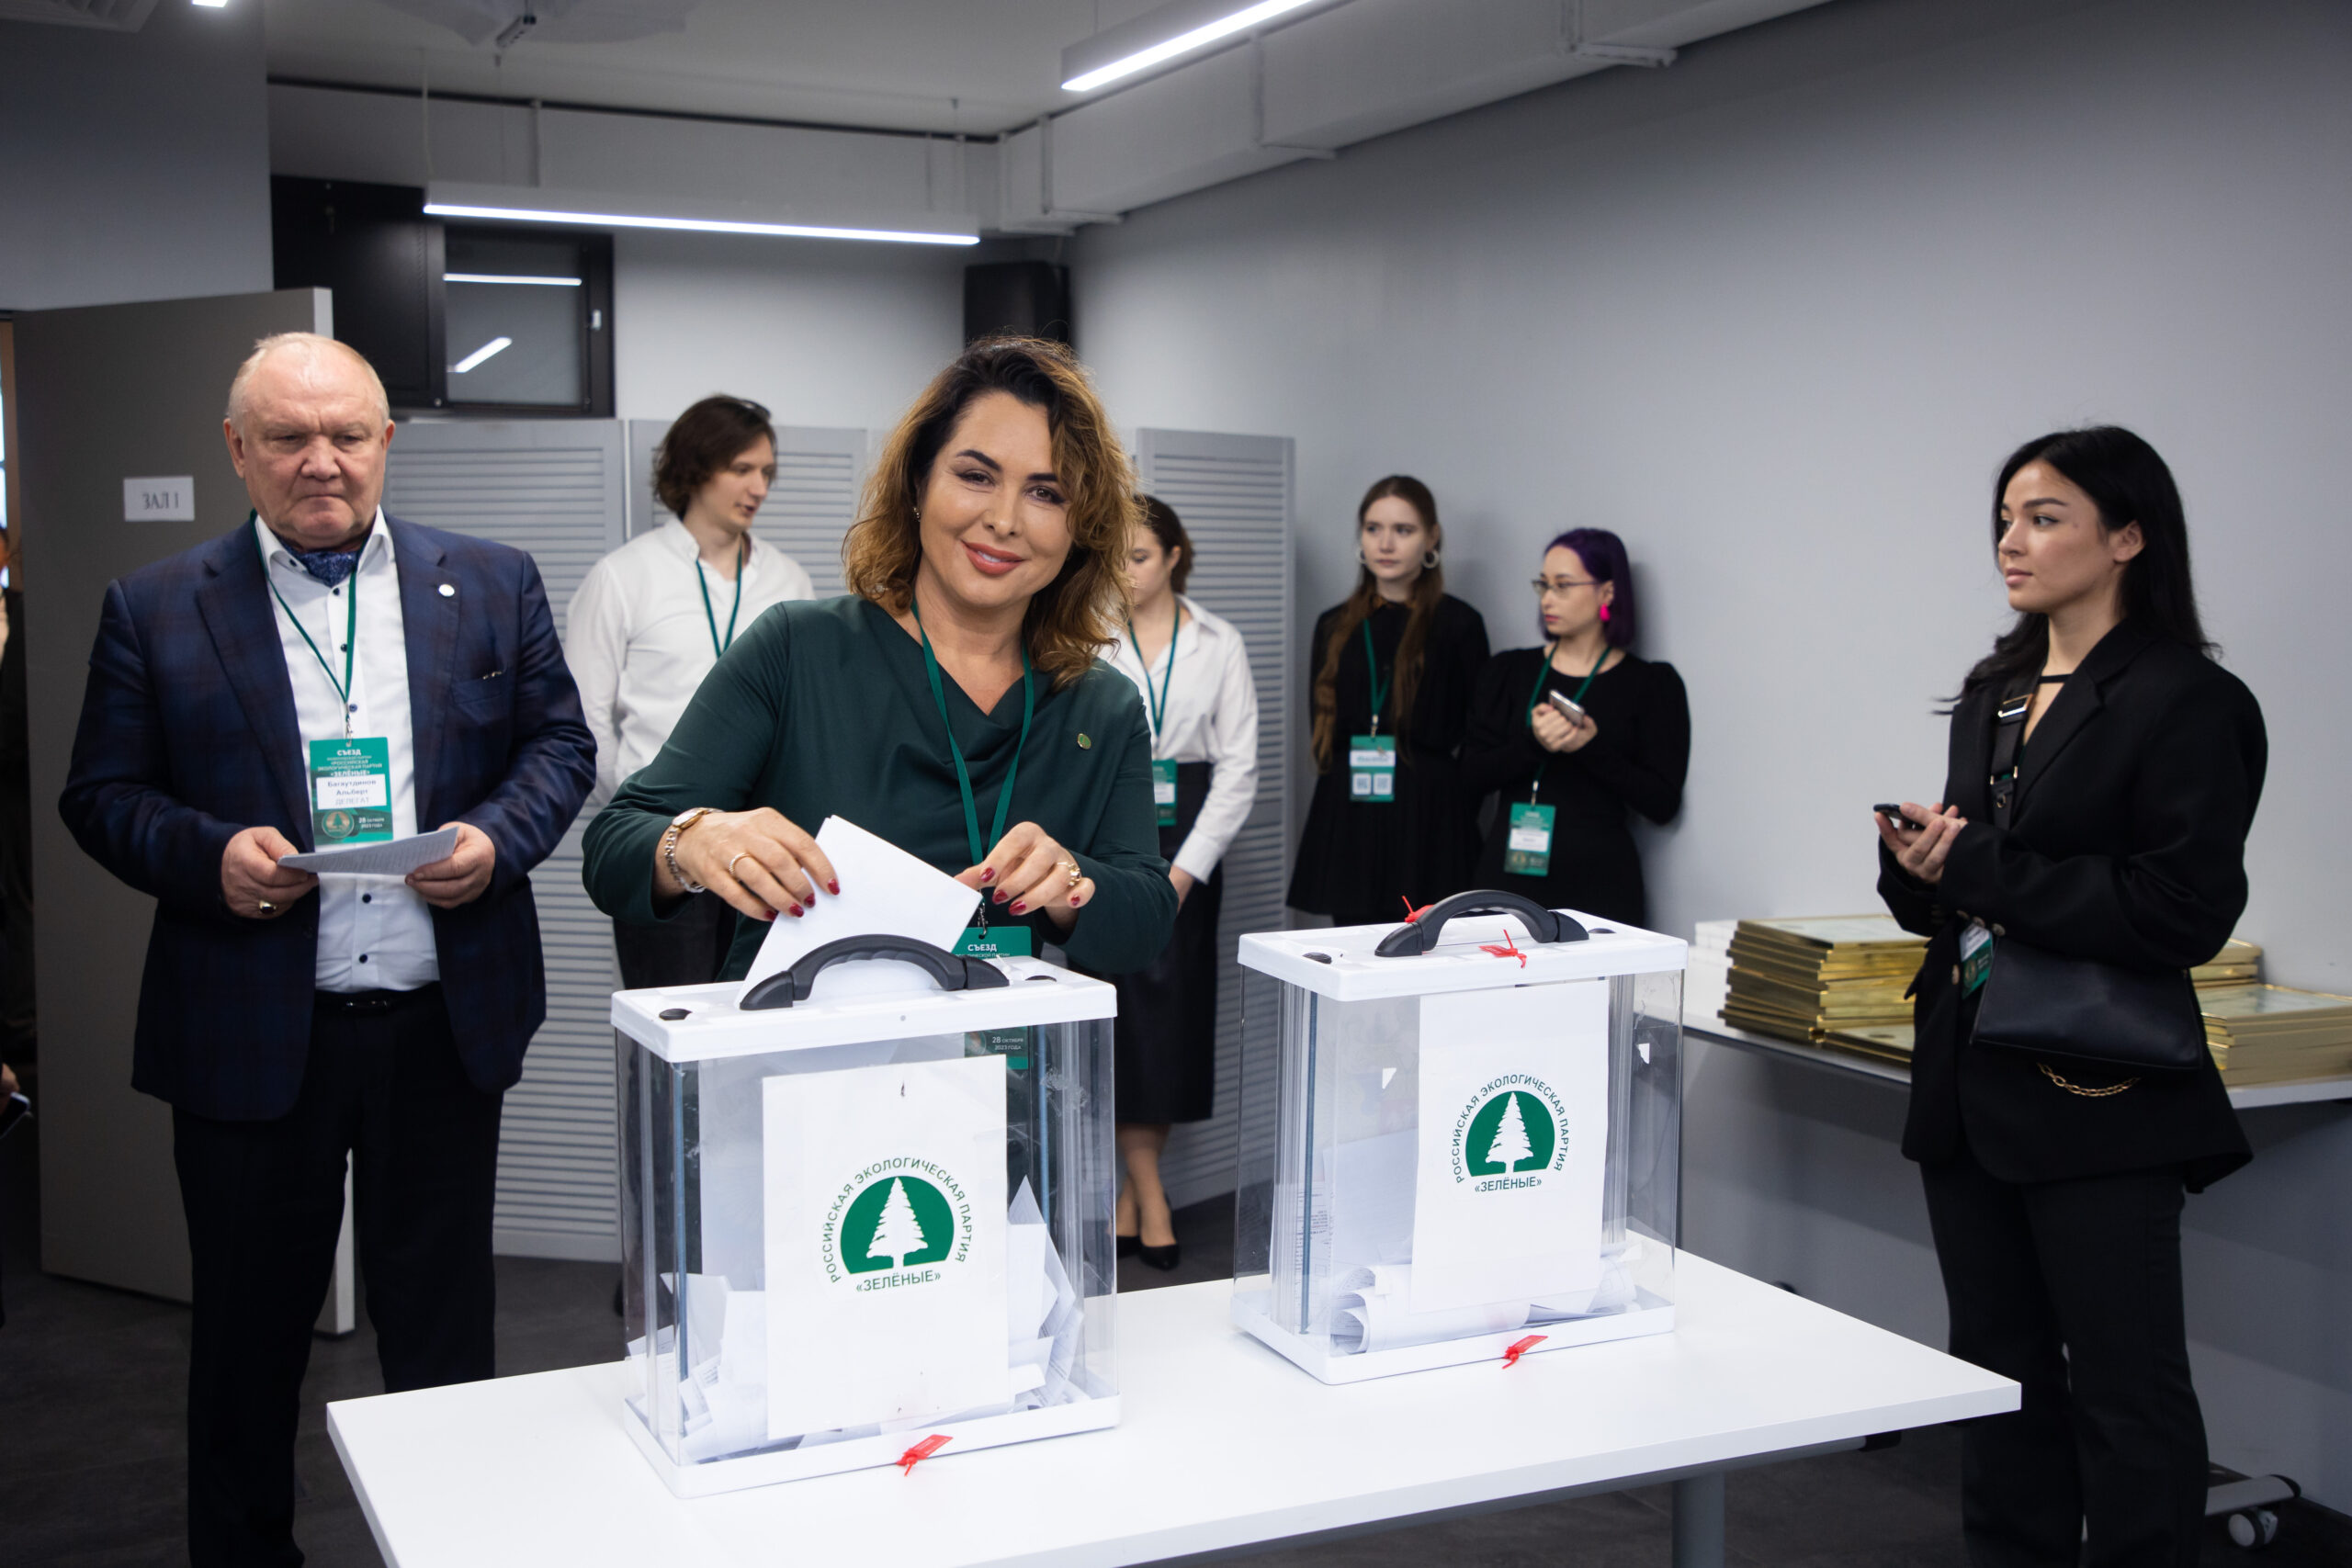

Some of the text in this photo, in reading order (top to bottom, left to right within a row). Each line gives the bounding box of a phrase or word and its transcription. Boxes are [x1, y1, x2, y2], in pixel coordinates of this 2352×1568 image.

[141, 491, 169, 510] ЗАЛ
[336, 749, 362, 757] СЪЕЗД
[967, 943, 998, 953] СЪЕЗД
[1452, 1074, 1569, 1183] РОССИЙСКАЯ ЭКОЛОГИЧЕСКАЯ ПАРТИЯ
[1475, 1176, 1542, 1192] «ЗЕЛЁНЫЕ»
[822, 1157, 972, 1283] РОССИЙСКАЯ ЭКОЛОГИЧЕСКАЯ ПАРТИЯ
[856, 1269, 941, 1292] «ЗЕЛЁНЫЕ»
